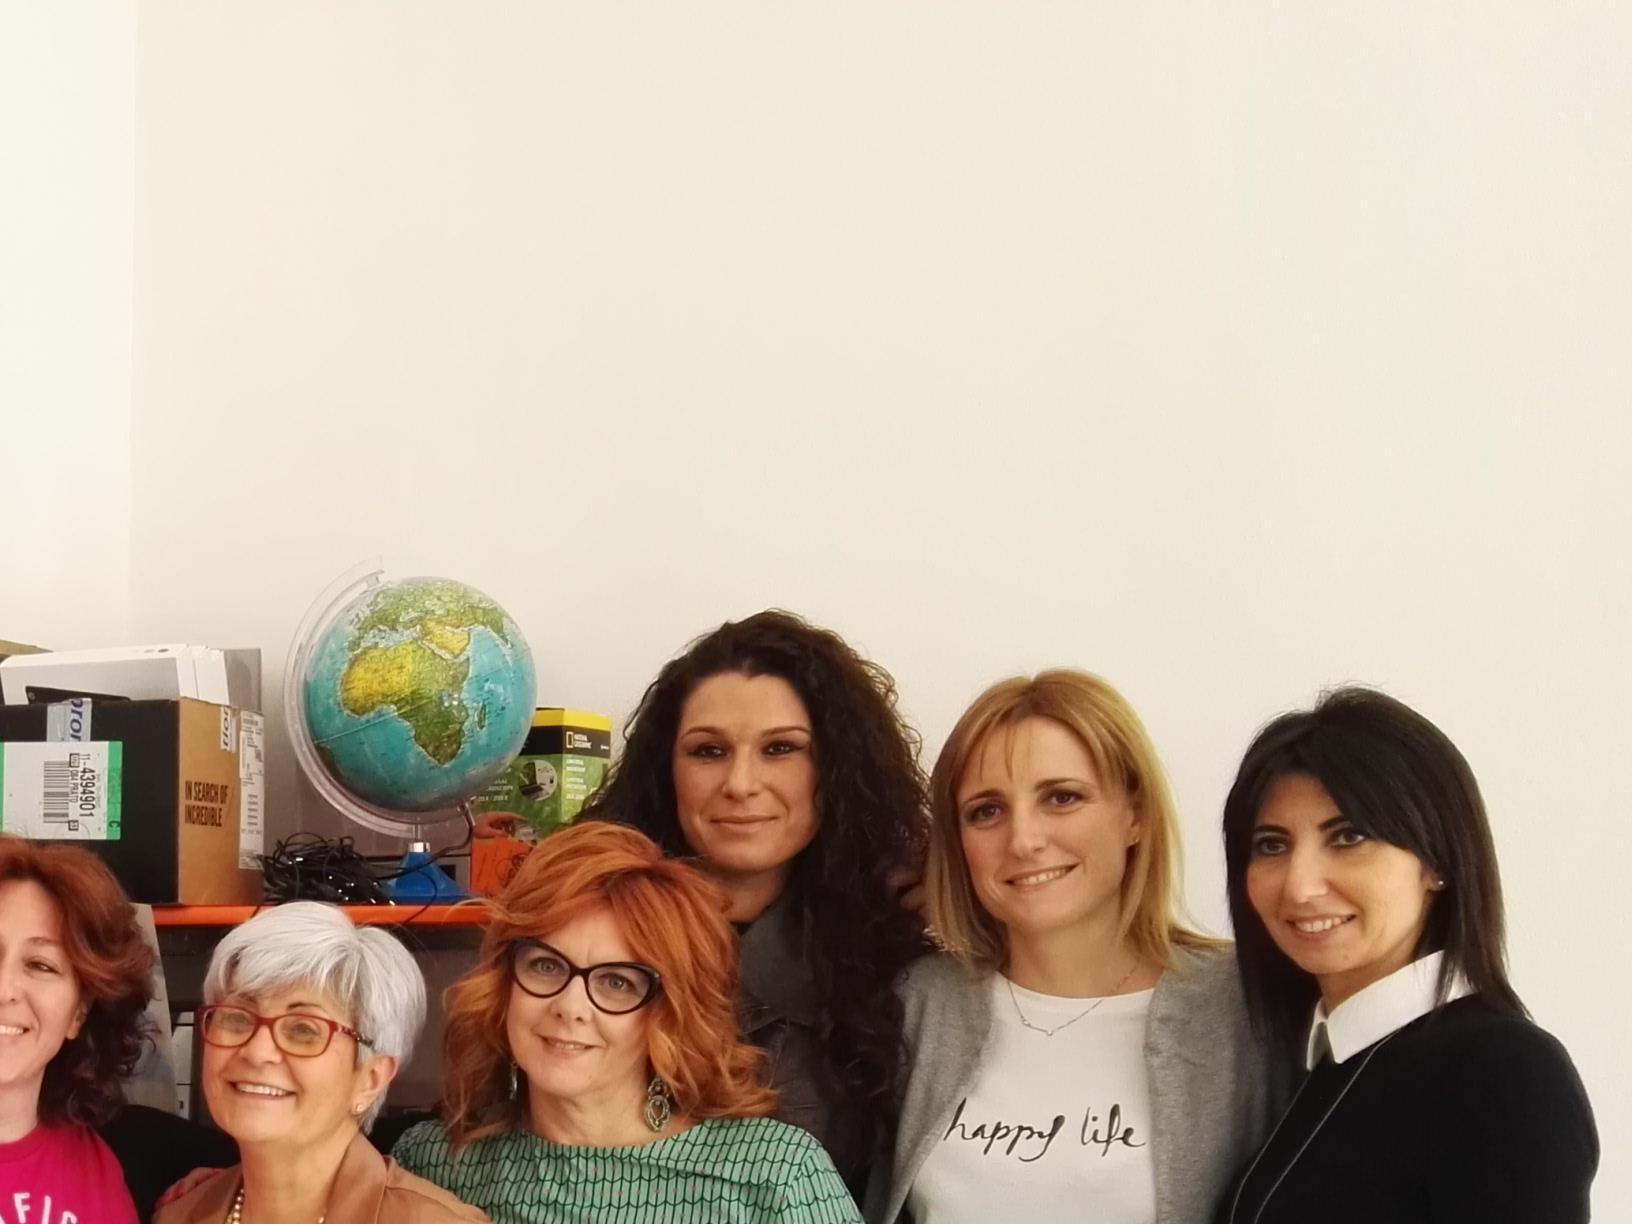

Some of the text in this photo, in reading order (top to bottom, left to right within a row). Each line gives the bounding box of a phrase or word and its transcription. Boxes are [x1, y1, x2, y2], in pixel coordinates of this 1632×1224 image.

[184, 780, 229, 805] IN SEARCH OF
[184, 804, 223, 828] INCREDIBLE
[943, 1096, 1146, 1162] happy life
